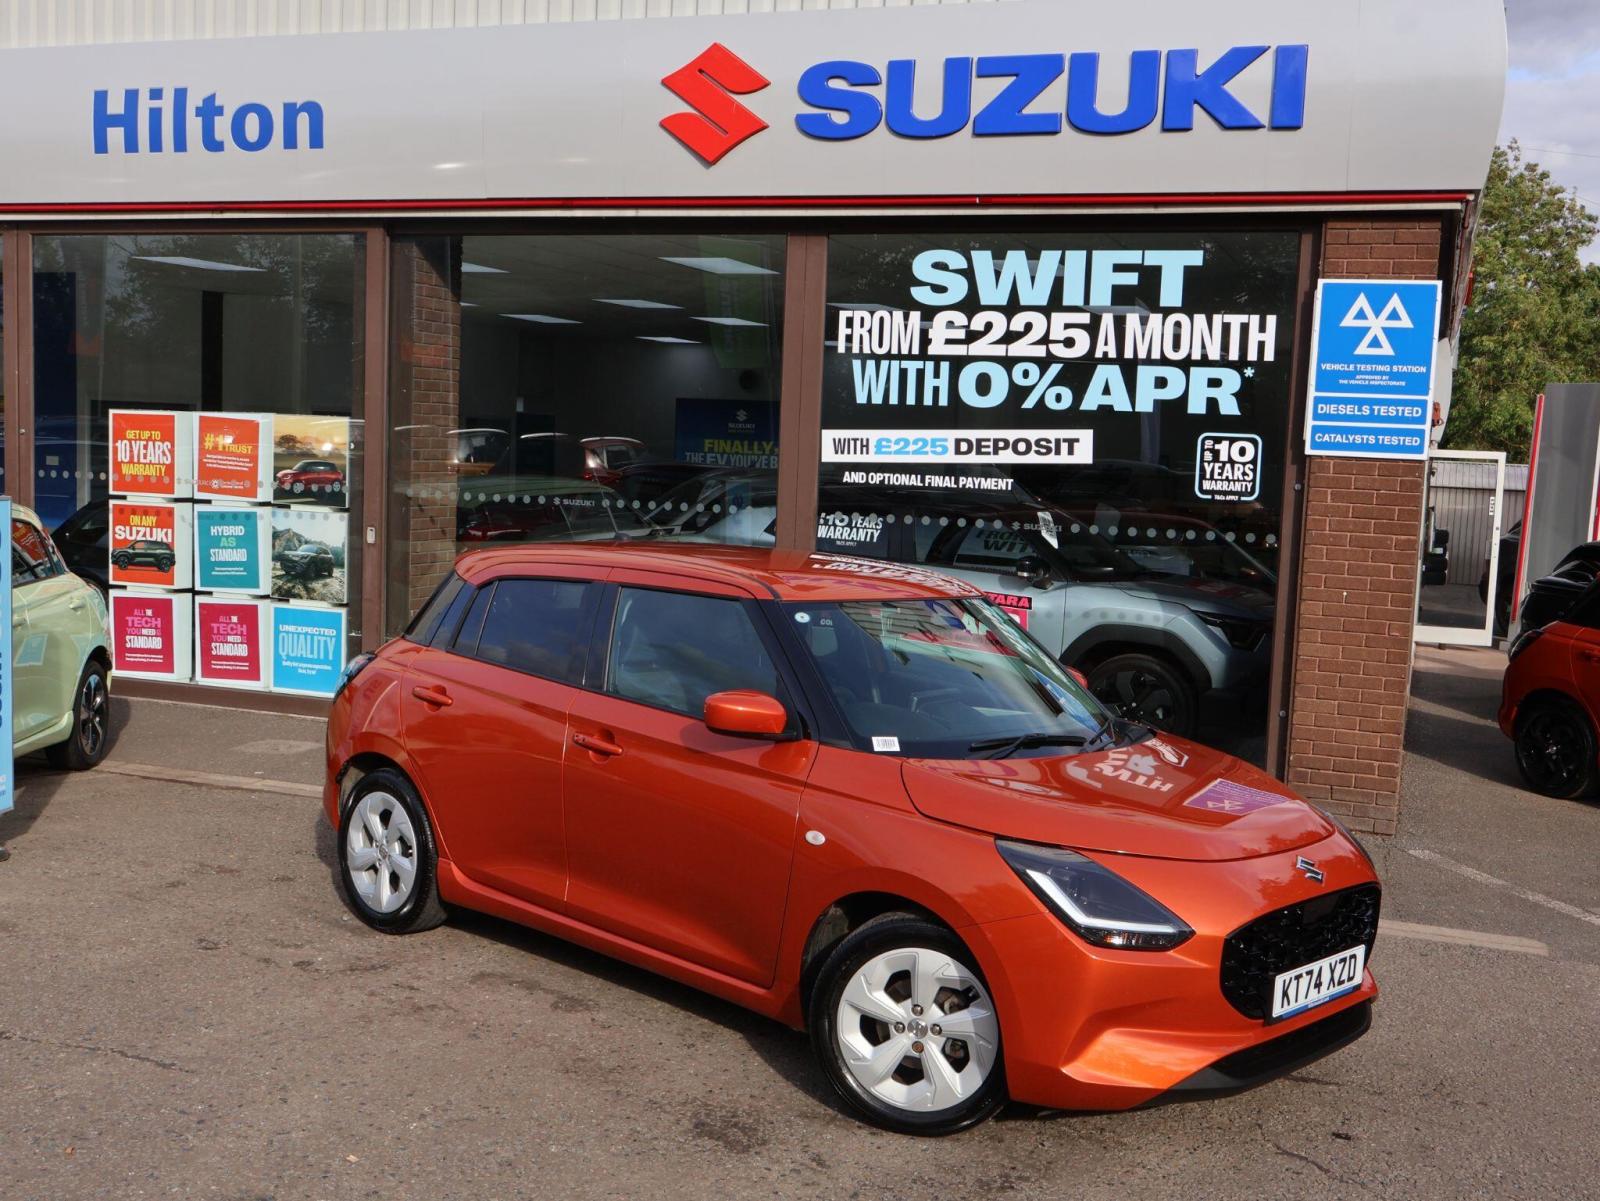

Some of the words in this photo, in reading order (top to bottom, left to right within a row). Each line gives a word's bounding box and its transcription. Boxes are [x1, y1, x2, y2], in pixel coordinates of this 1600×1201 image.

[795, 43, 1308, 140] SUZUKI
[93, 87, 324, 154] Hilton
[910, 249, 1203, 307] SWIFT
[838, 309, 920, 355] FROM
[928, 310, 1090, 358] £225
[1095, 312, 1115, 358] A
[1124, 313, 1277, 362] MONTH
[1321, 363, 1355, 371] VEHICLE
[1356, 364, 1390, 372] TESTING
[1392, 365, 1427, 373] STATION
[852, 359, 950, 406] WITH
[958, 360, 1073, 411] 0%
[1317, 404, 1370, 416] DIESELS
[1372, 405, 1422, 417] TESTED
[126, 430, 140, 439] GET
[141, 431, 150, 440] UP
[151, 431, 161, 440] TO
[1315, 433, 1376, 444] CATALYSTS
[1377, 435, 1420, 446] TESTED
[115, 440, 130, 462] 10
[132, 440, 172, 464] YEARS
[225, 444, 253, 454] TRUST
[833, 437, 869, 455] WITH
[874, 437, 949, 456] £225
[954, 437, 1080, 456] DEPOSIT
[1214, 440, 1255, 463] 10
[685, 451, 705, 464] THE
[706, 452, 728, 465] EV
[1203, 450, 1213, 461] UP
[121, 463, 166, 476] WARRANTY
[1203, 462, 1254, 481] YEARS
[843, 471, 867, 483] AND
[868, 472, 923, 487] OPTIONAL
[925, 475, 957, 489] FINAL
[959, 477, 1013, 491] PAYMENT
[1202, 480, 1253, 492] WARRANTY
[562, 498, 595, 507] SUZUKI
[130, 515, 142, 526] ON
[142, 515, 158, 527] ANY
[851, 515, 883, 530] YEARS
[114, 526, 173, 543] SUZUKI
[210, 525, 245, 536] HYBRID
[817, 525, 881, 543] WARRANTY
[220, 537, 236, 547] AS
[210, 548, 247, 562] STANDARD
[133, 609, 145, 617] ALL
[219, 615, 230, 623] ALL
[125, 616, 161, 629] TECH
[211, 623, 247, 635] TECH
[126, 628, 141, 636] YOU
[142, 628, 156, 636] NEED
[279, 624, 336, 636] UNEXPECTED
[125, 635, 162, 650] STANDARD
[227, 635, 242, 643] NEED
[211, 642, 248, 657] STANDARD
[279, 632, 336, 660] QUALITY
[1281, 966, 1323, 1009] KT74
[1326, 953, 1357, 991] XZD
